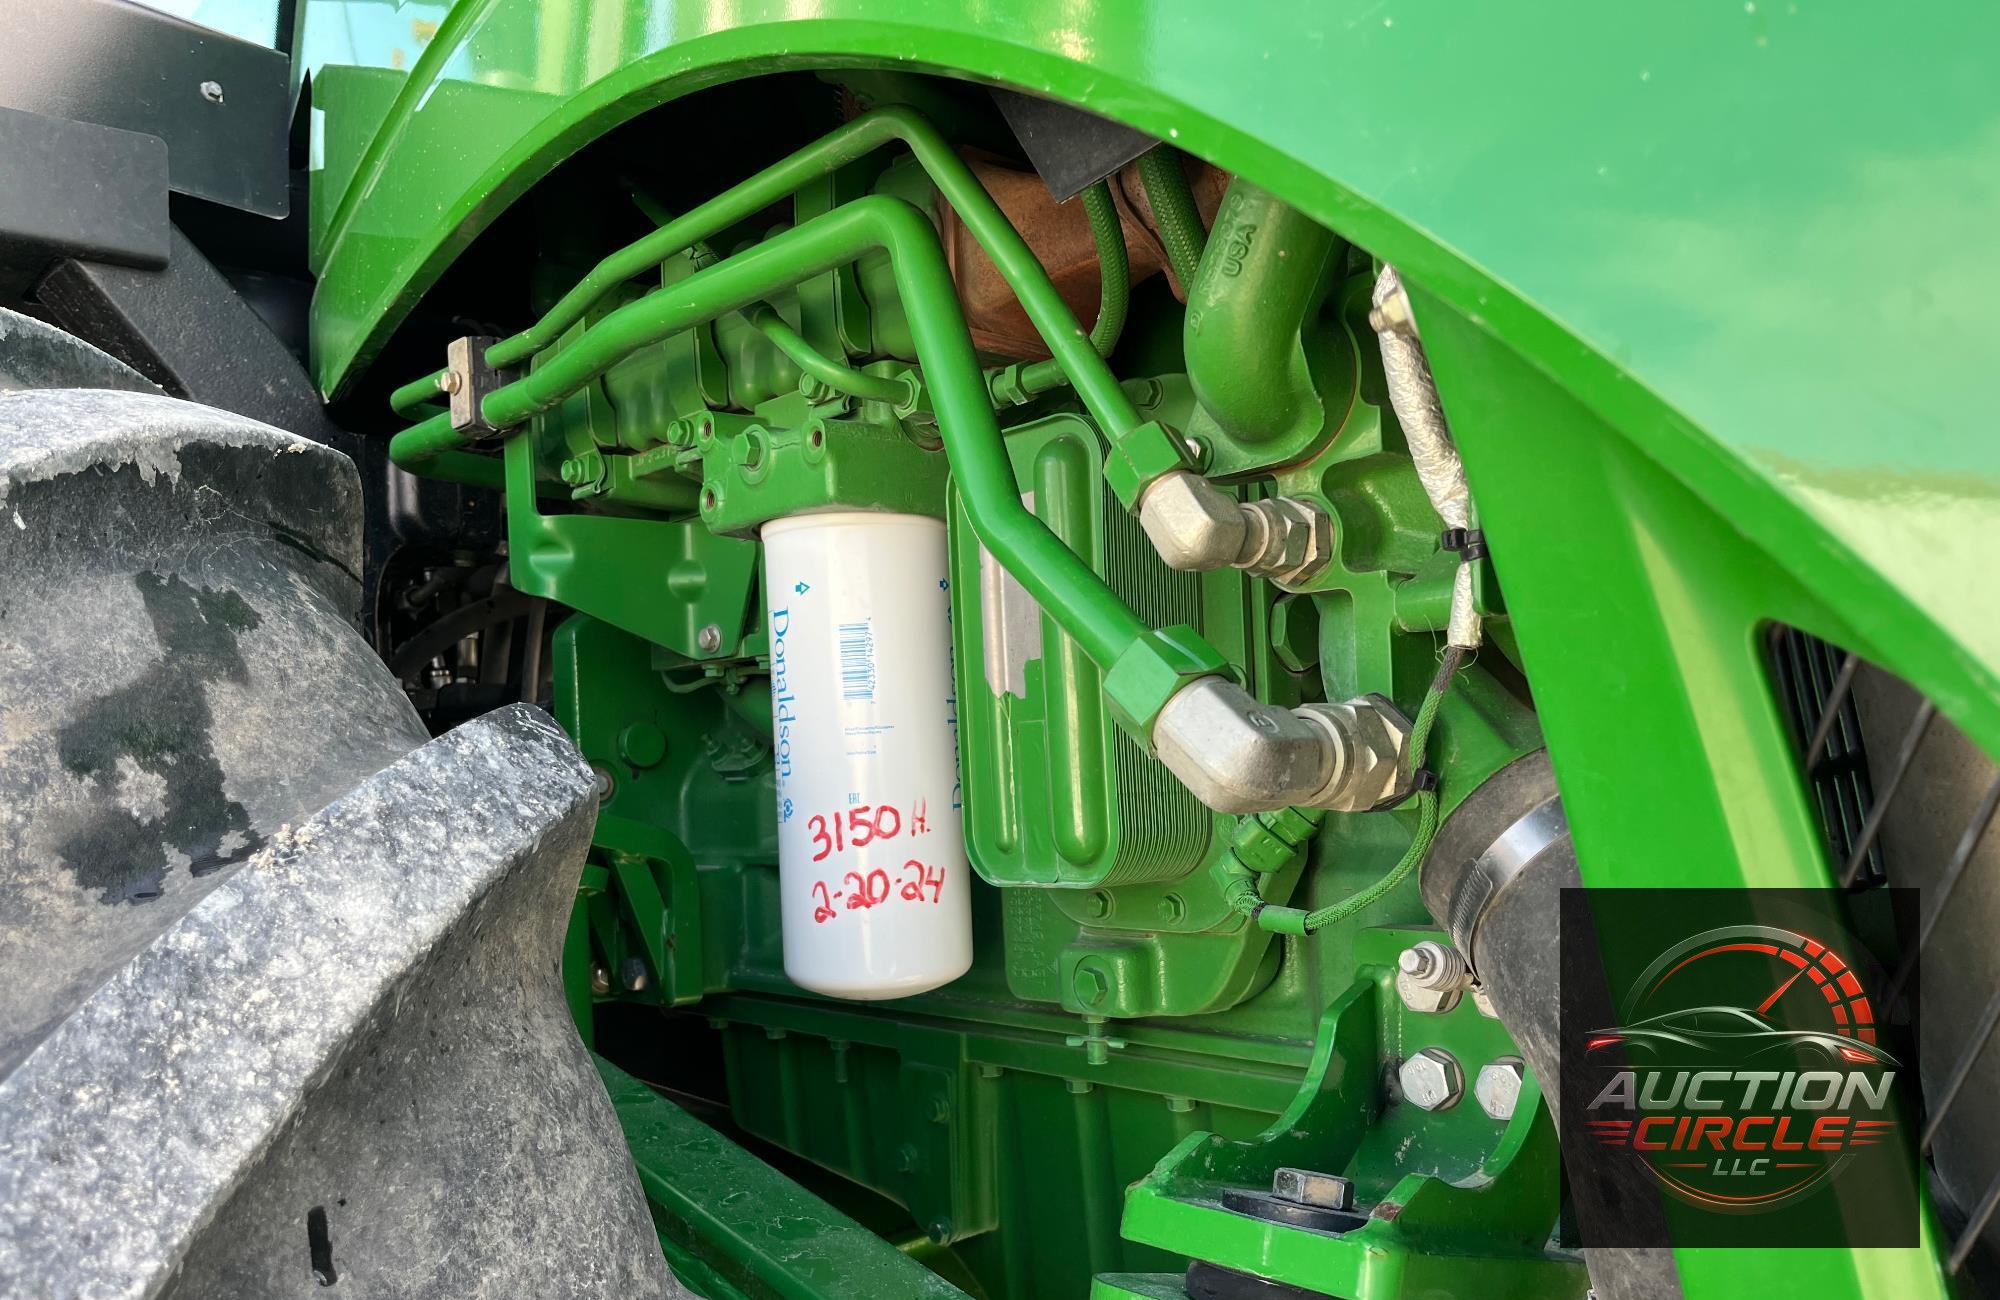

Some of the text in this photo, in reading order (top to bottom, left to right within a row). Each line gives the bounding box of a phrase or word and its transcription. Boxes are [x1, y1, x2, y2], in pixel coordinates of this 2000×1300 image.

[1222, 224, 1257, 277] USA
[773, 606, 796, 777] Donaldson
[808, 805, 901, 862] 3150
